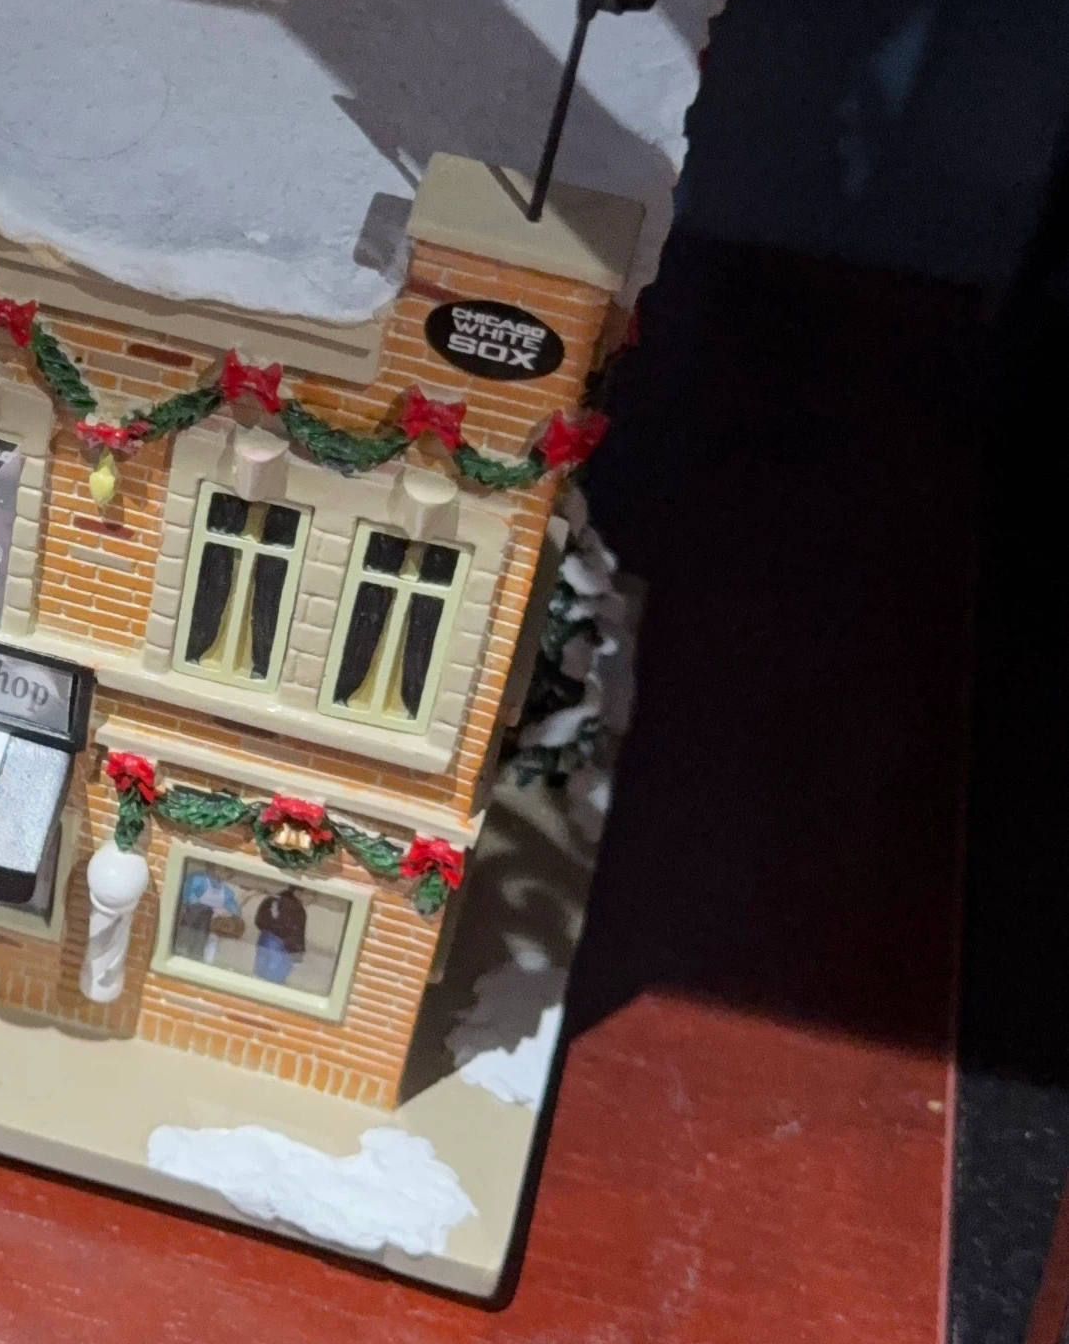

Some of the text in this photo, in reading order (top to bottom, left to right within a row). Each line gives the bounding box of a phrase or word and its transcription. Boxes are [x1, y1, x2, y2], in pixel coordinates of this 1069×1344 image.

[451, 307, 547, 339] CHICAGO
[453, 318, 543, 352] WHITE
[447, 333, 538, 371] SOX
